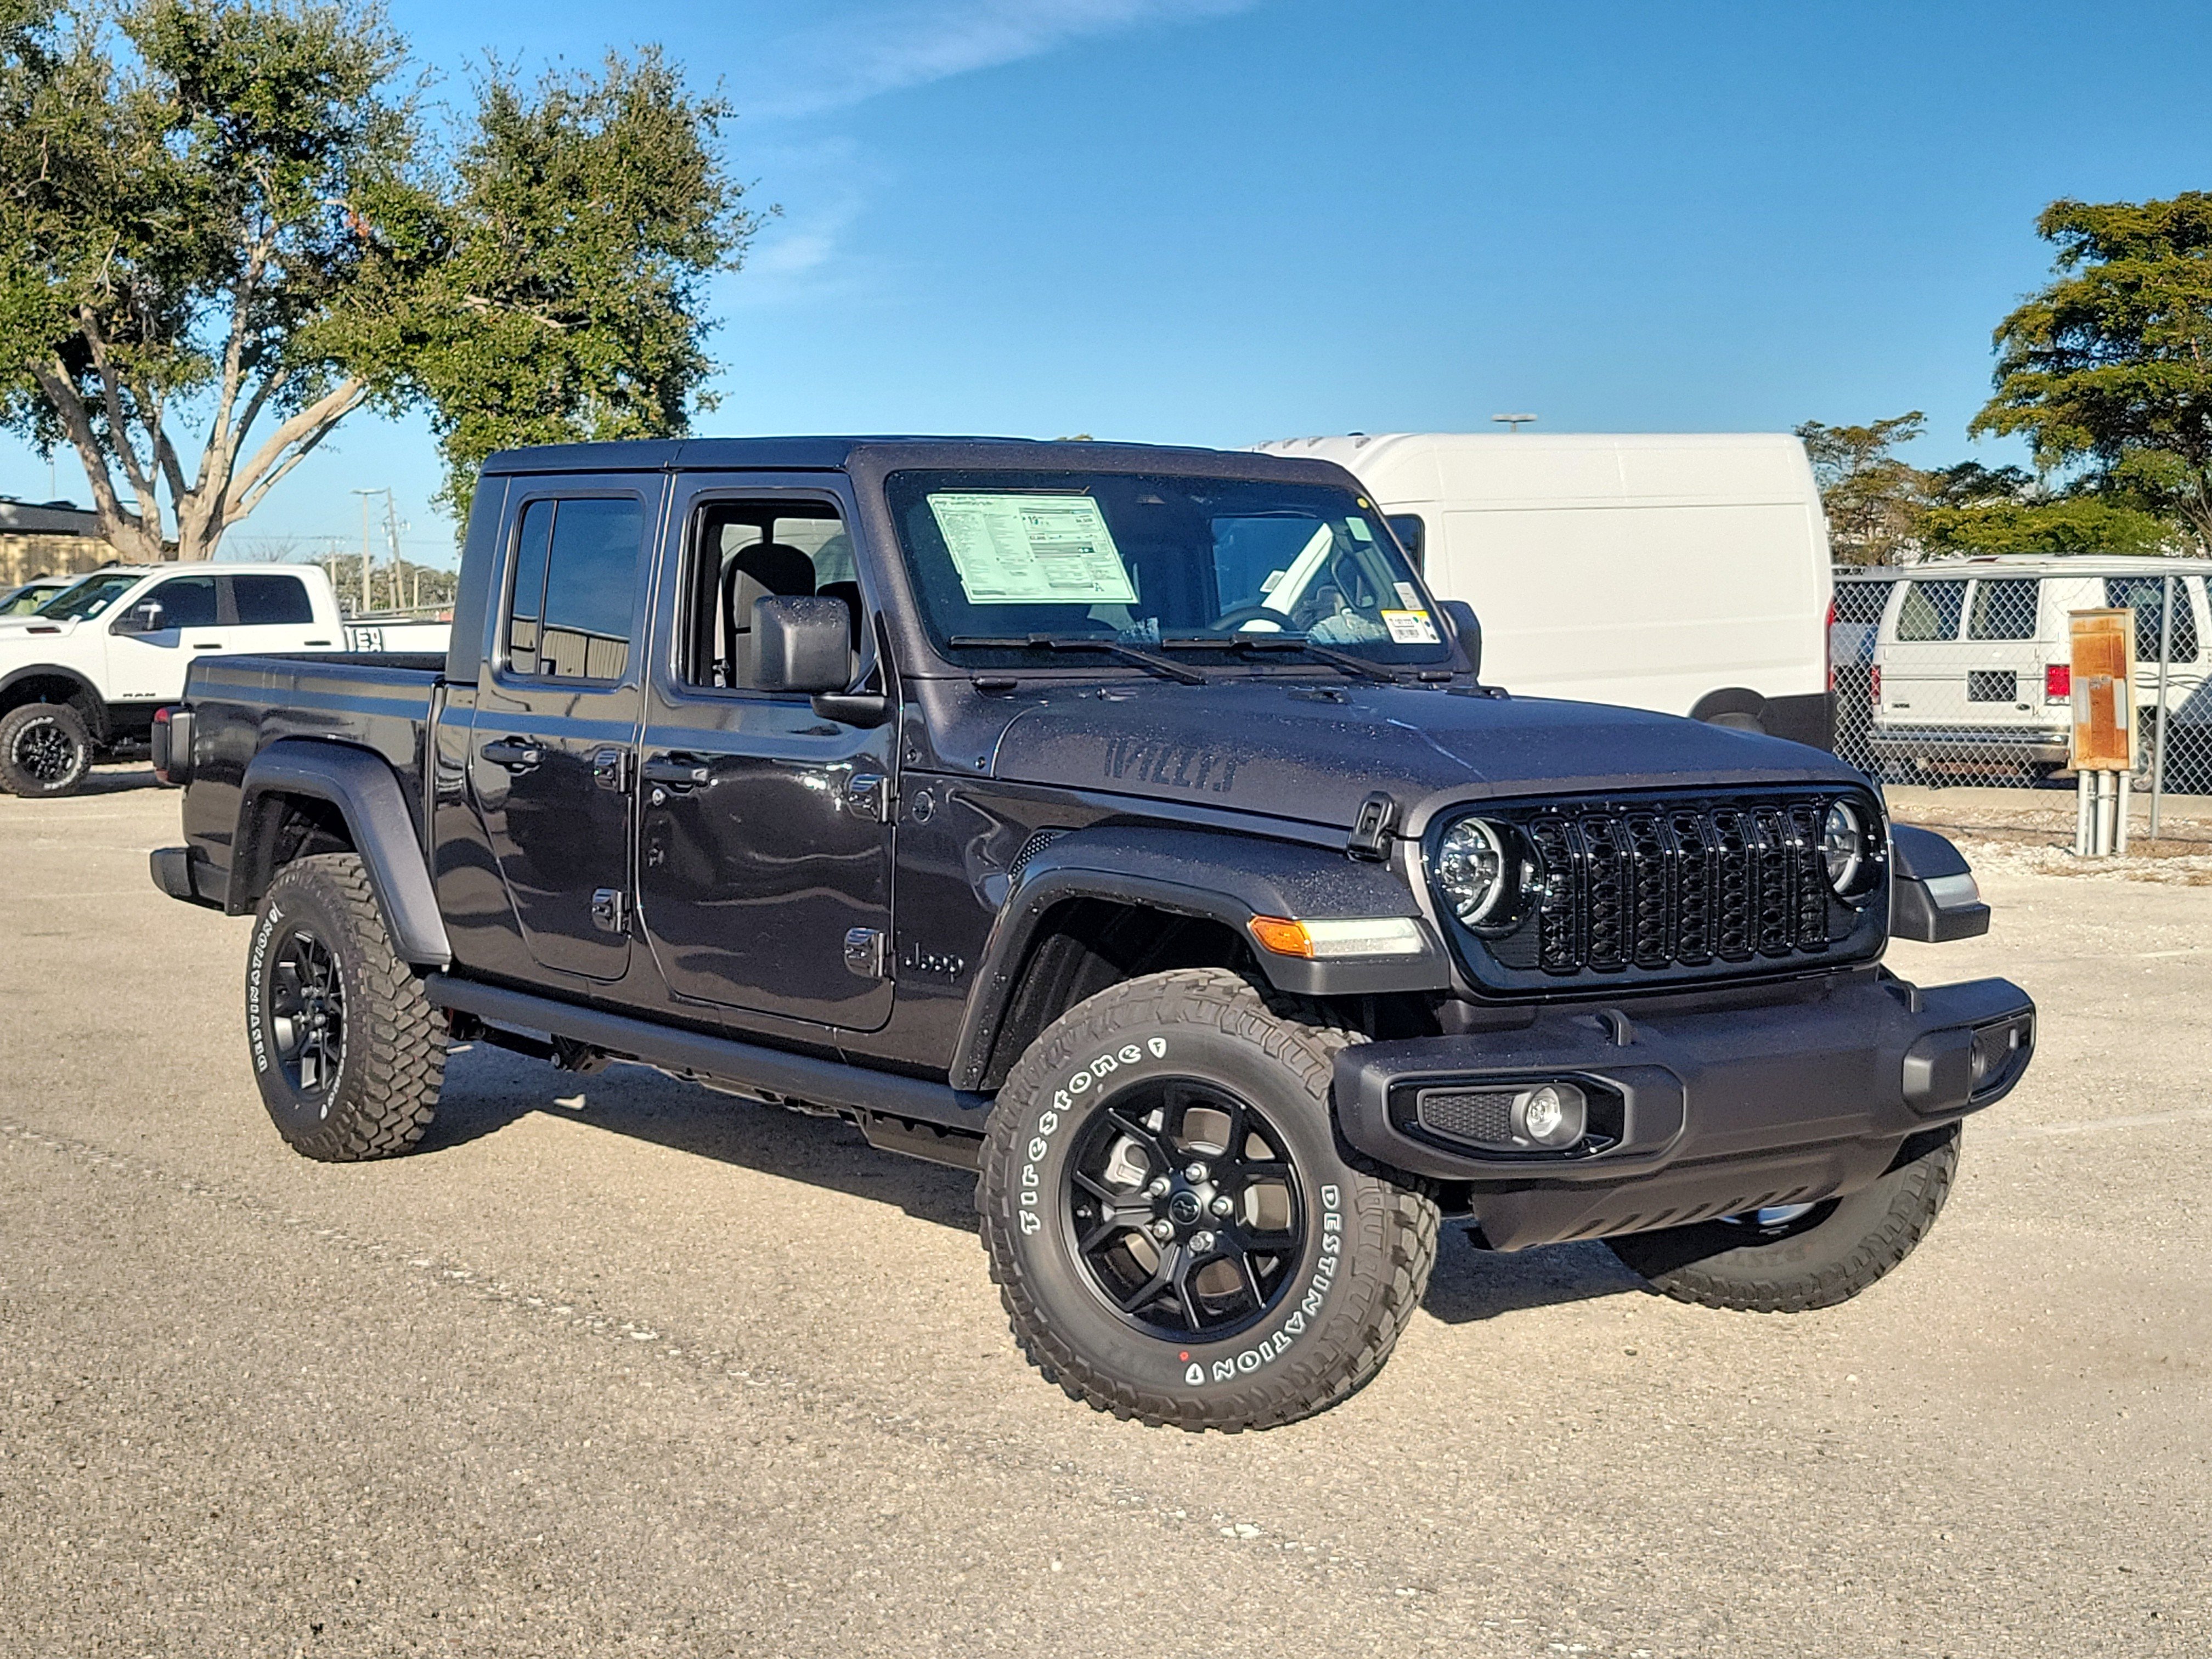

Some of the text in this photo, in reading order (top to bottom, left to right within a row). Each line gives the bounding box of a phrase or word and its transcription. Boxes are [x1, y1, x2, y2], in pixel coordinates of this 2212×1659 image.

[250, 918, 273, 1073] DESTINATION
[904, 942, 964, 984] Jeep
[1018, 1044, 1142, 1235] Firestone
[1211, 1184, 1342, 1382] DESTINATION
